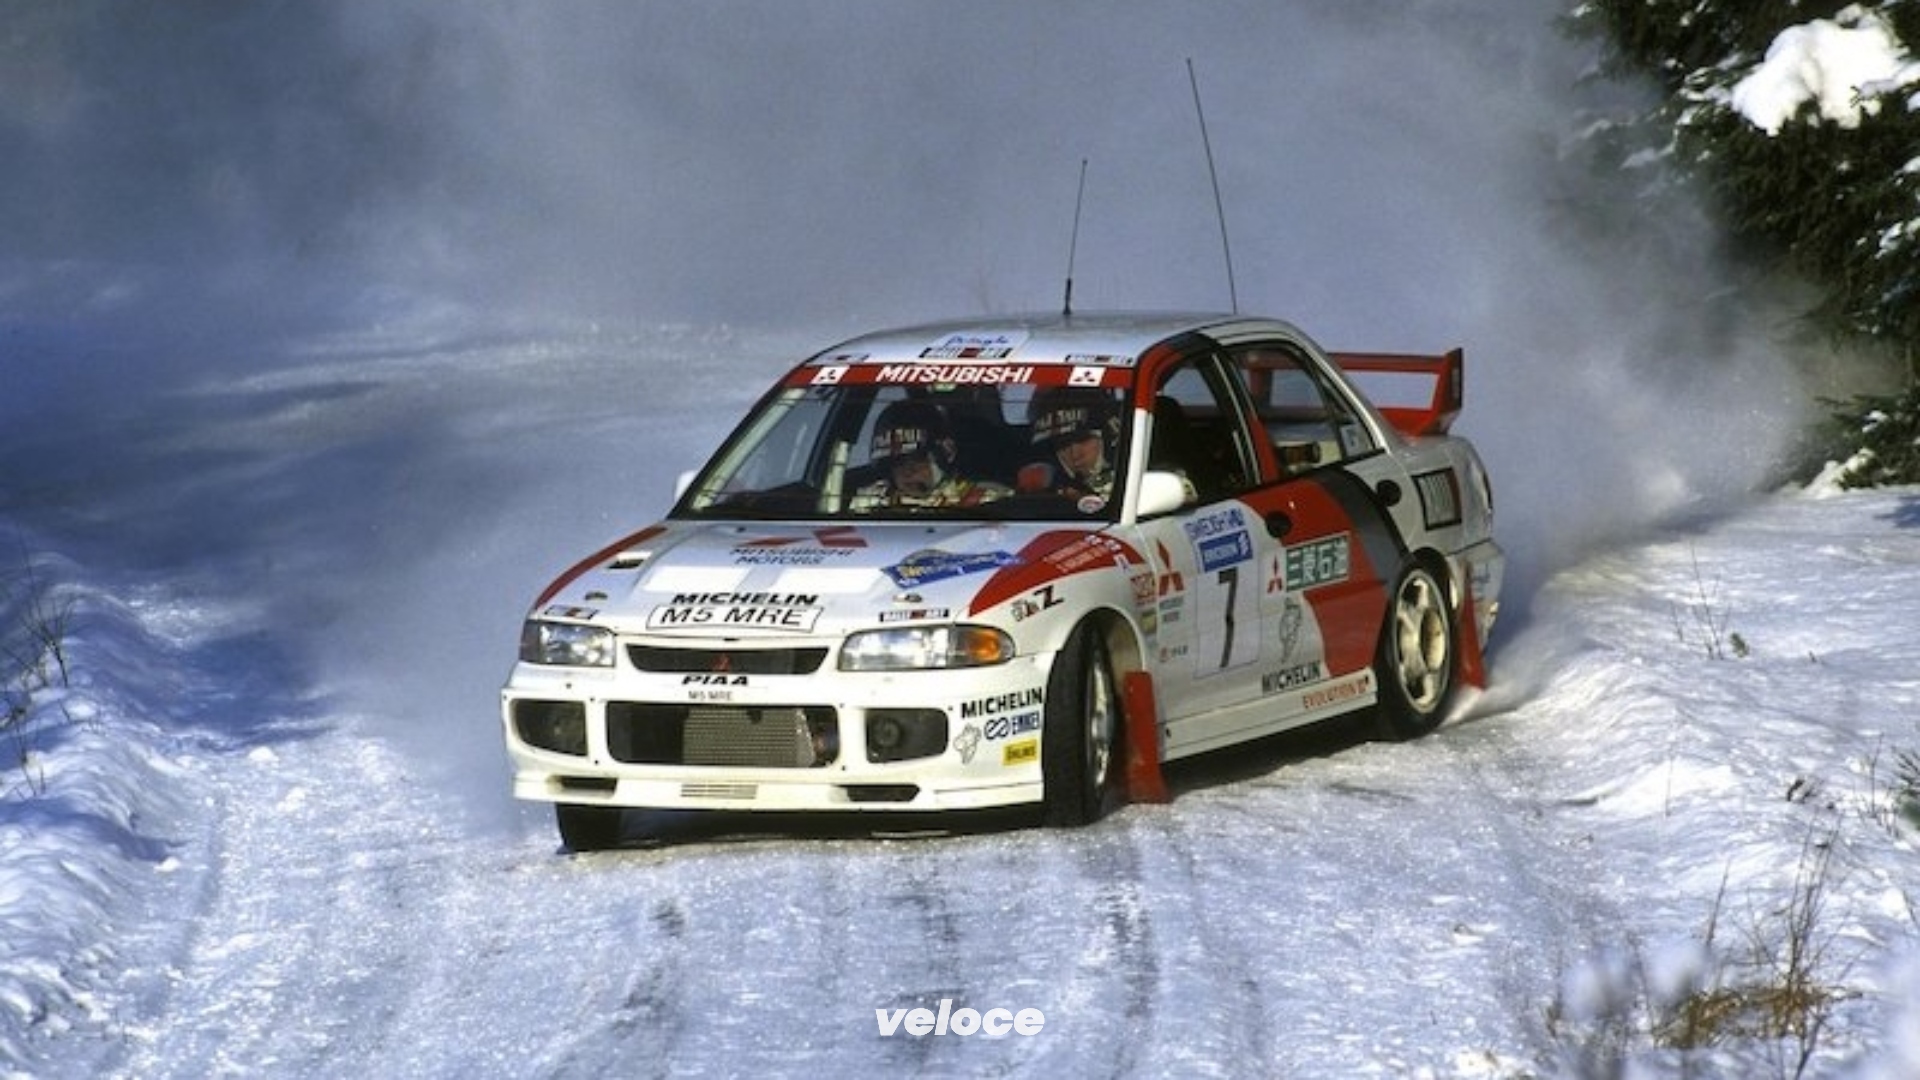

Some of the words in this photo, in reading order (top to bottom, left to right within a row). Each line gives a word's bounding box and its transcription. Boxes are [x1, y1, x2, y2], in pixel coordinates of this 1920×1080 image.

[875, 366, 1034, 382] MITSUBISHI
[730, 549, 856, 558] MITSUBISHI
[734, 556, 825, 565] MOTORS
[672, 592, 819, 606] MICHELIN
[660, 606, 713, 624] M5
[724, 607, 805, 626] MRE
[1218, 567, 1238, 668] 7
[682, 675, 748, 685] PIAA
[1262, 660, 1321, 695] MICHELIN
[961, 686, 1043, 719] MICHELIN
